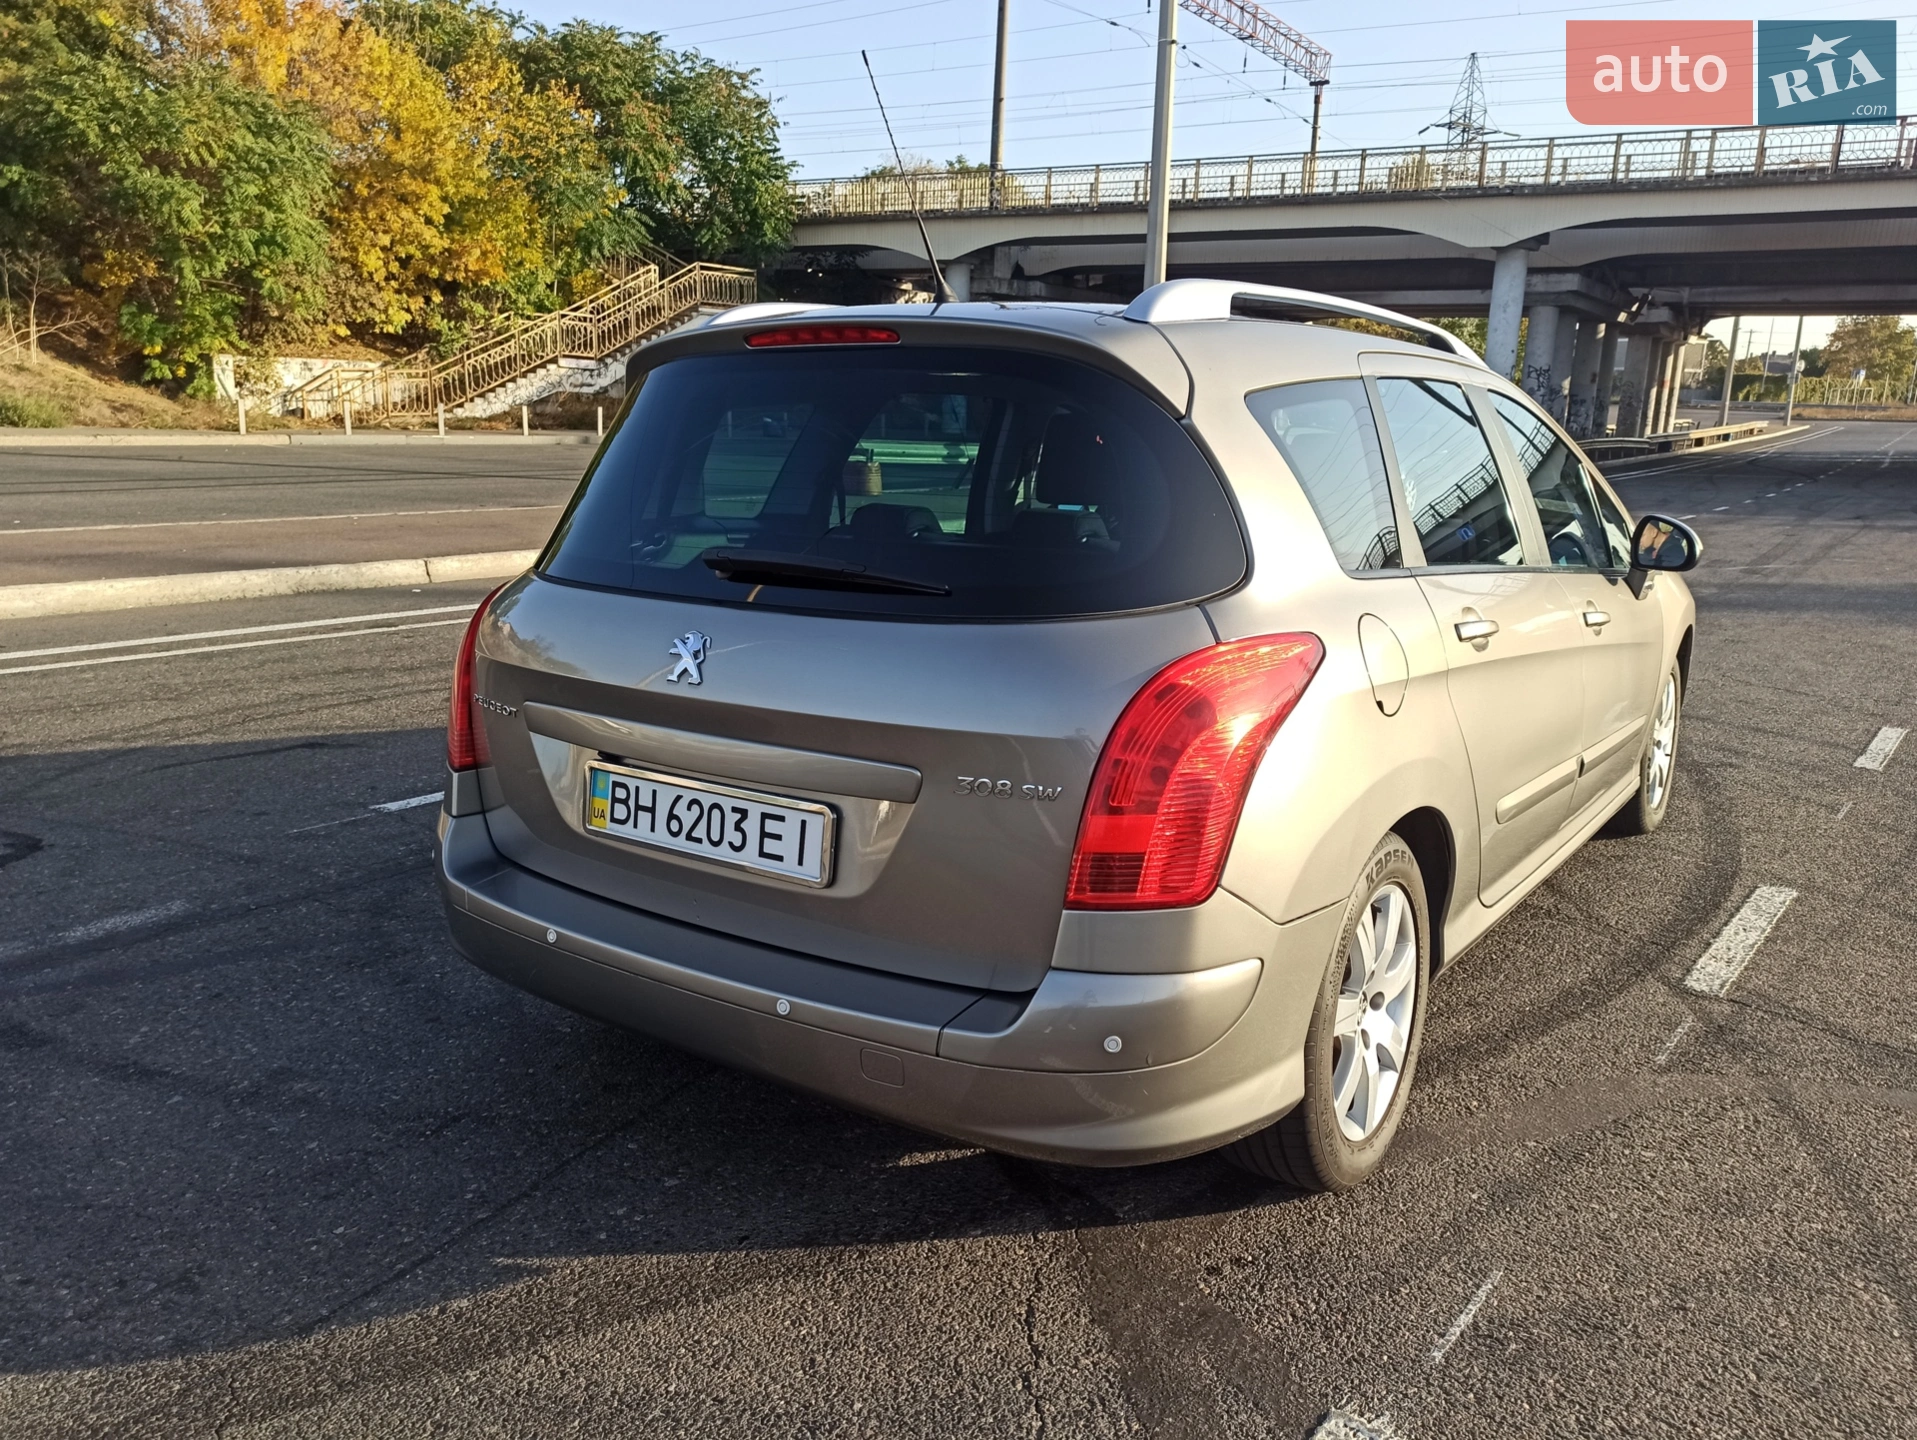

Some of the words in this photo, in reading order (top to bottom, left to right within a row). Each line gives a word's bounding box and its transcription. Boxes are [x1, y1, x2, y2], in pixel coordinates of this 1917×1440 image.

[473, 693, 518, 718] PEUGEOT
[953, 776, 1013, 799] 308
[1019, 784, 1062, 801] SW
[592, 806, 606, 821] UA
[609, 780, 657, 833] BH
[666, 794, 749, 853] 6203
[758, 811, 807, 867] EI
